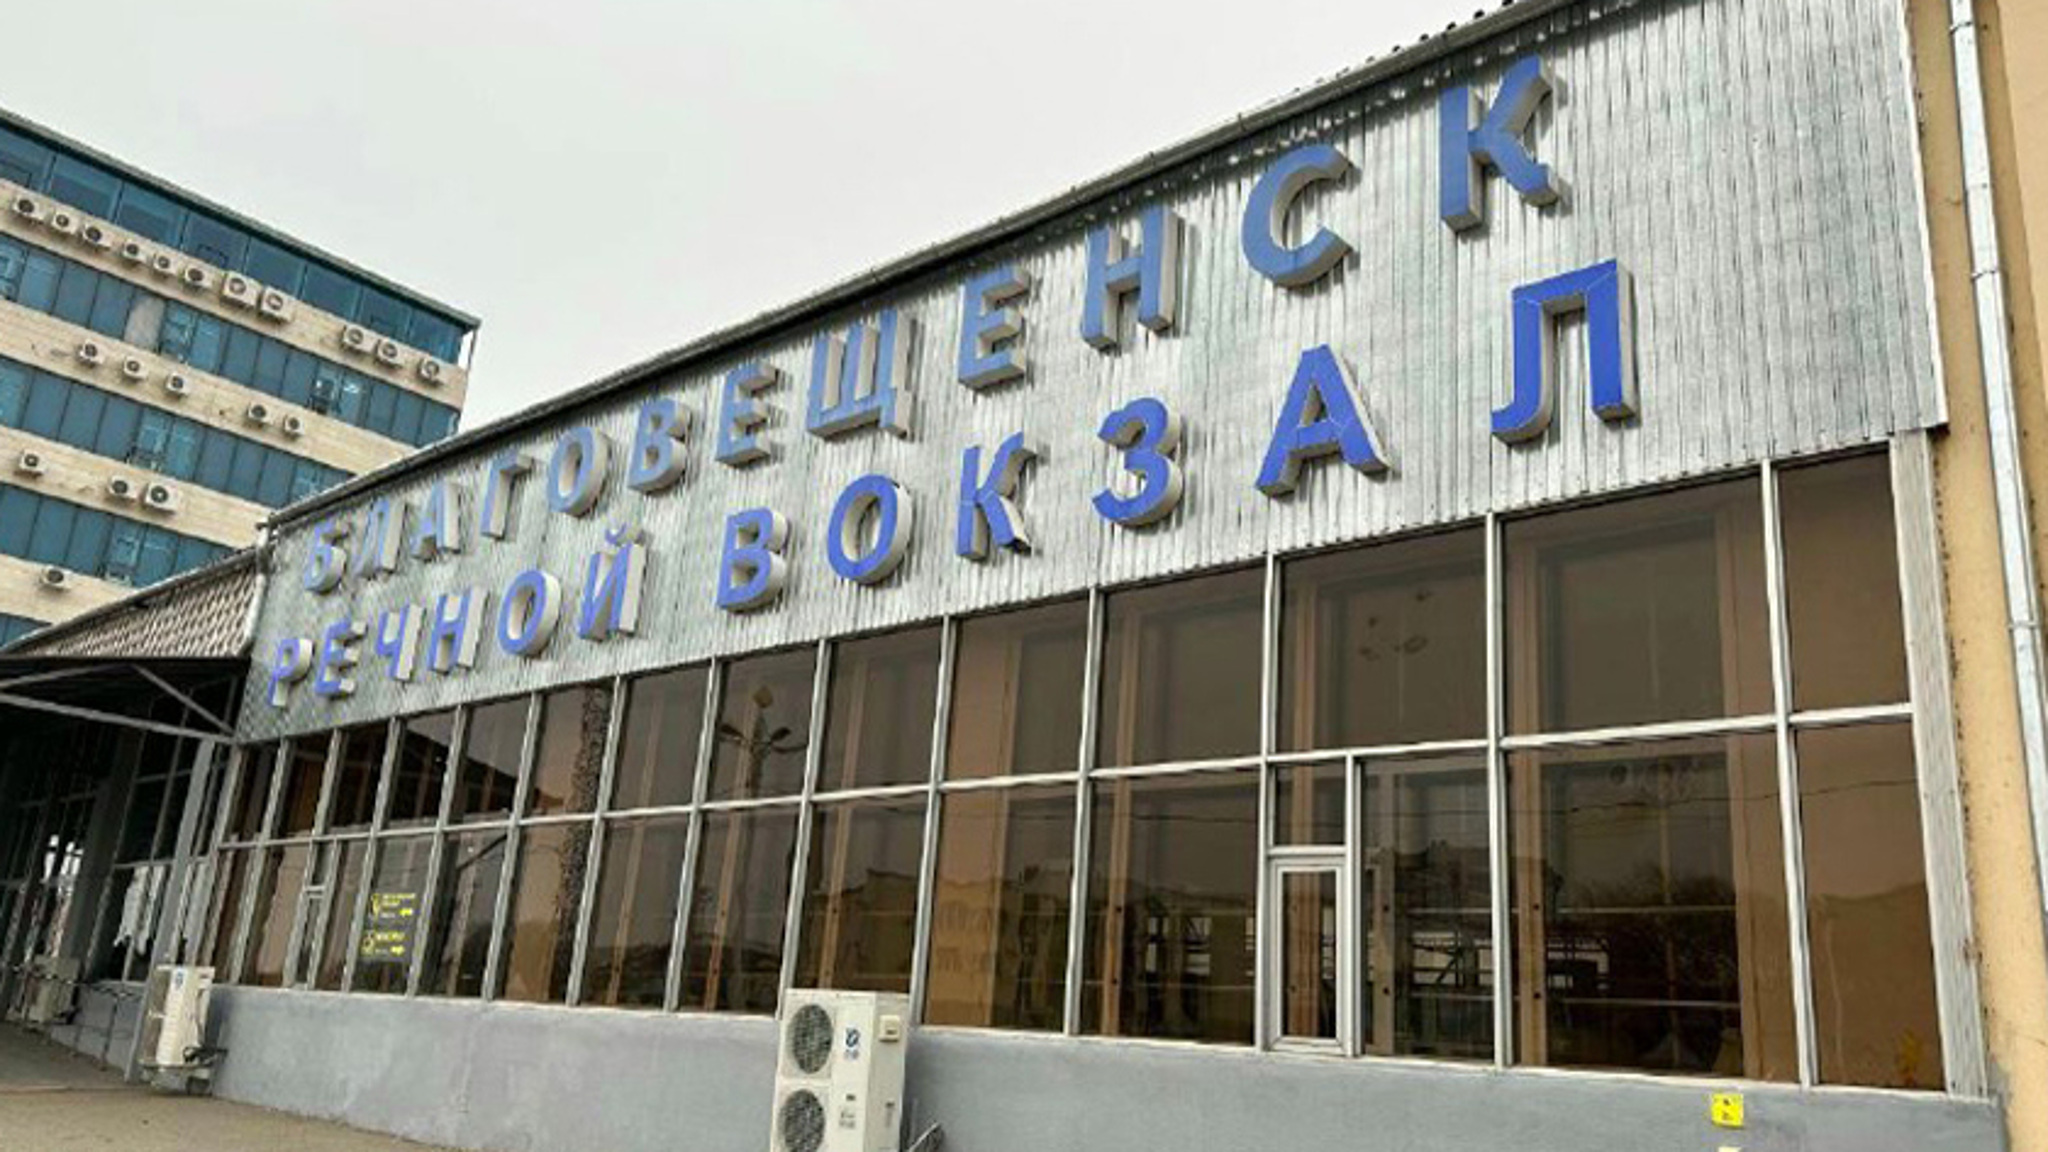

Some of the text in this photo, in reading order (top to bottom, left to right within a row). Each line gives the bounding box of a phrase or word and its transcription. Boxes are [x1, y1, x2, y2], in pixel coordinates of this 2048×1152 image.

[268, 258, 1637, 707] РЕЧНОЙ ВОКЗАЛ
[303, 53, 1560, 594] БЛАГОВЕЩЕНСК
